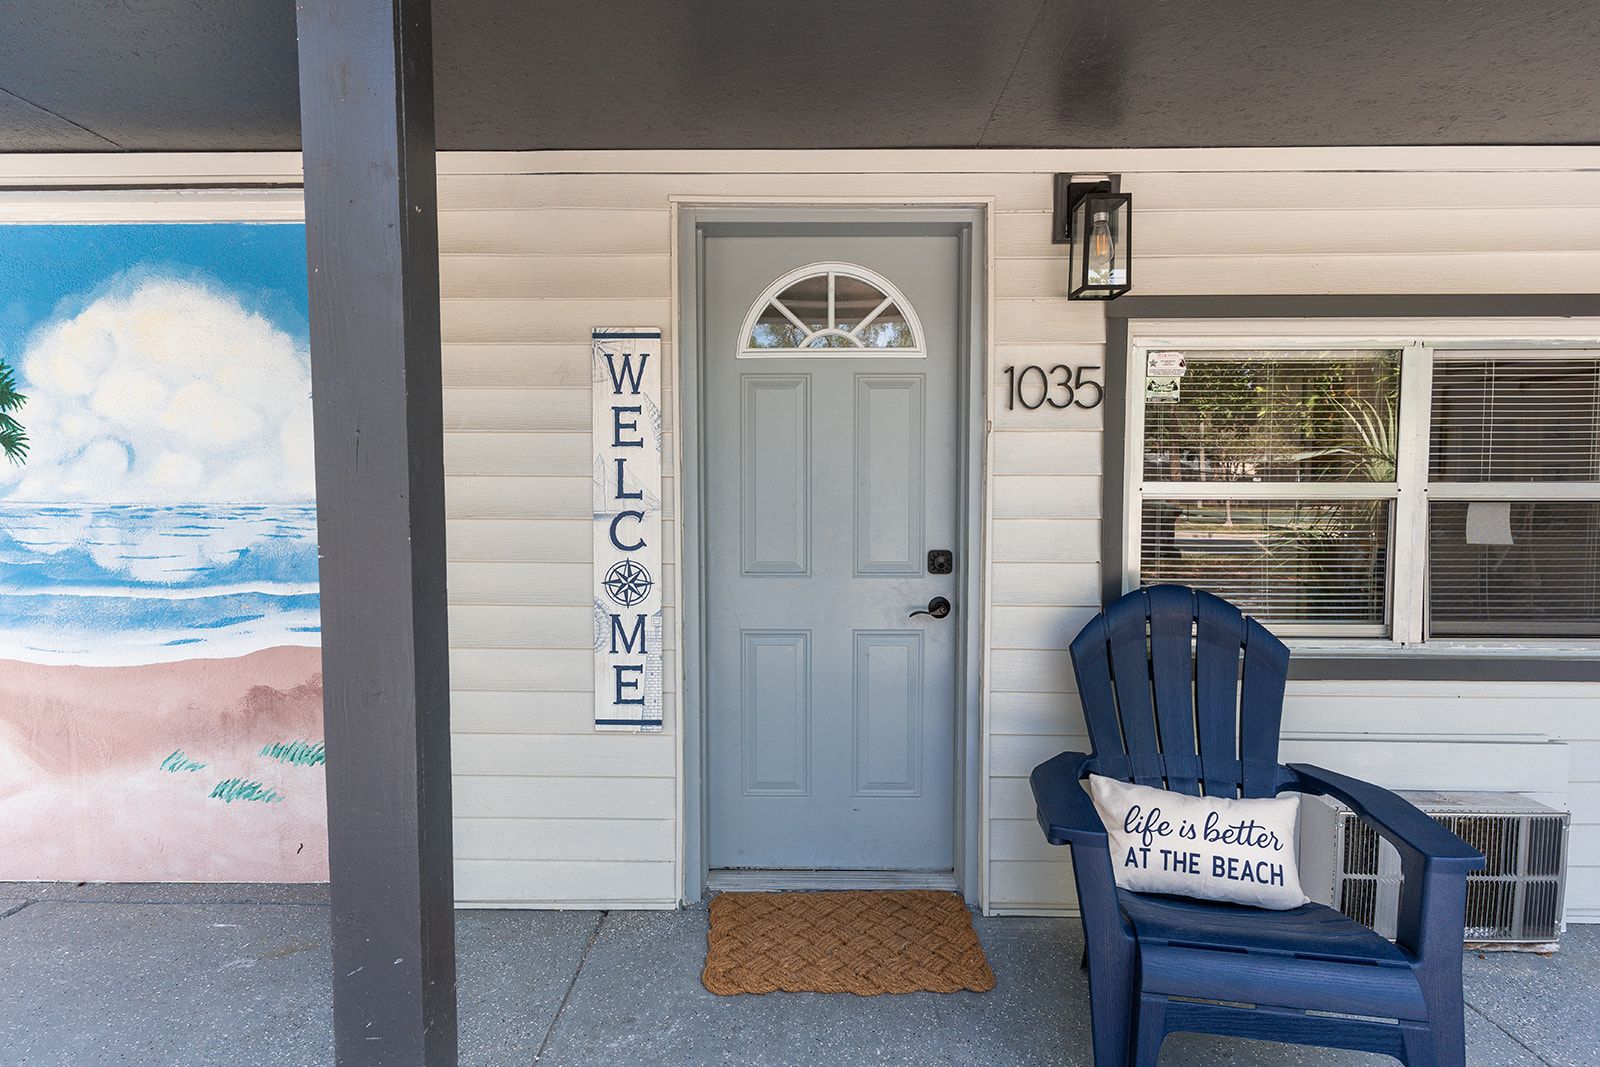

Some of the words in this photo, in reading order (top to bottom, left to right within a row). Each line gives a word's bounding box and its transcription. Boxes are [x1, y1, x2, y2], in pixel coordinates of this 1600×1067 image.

[1004, 364, 1103, 410] 1035
[1124, 805, 1173, 847] life
[1179, 820, 1197, 840] is
[1204, 811, 1284, 851] better
[1124, 847, 1151, 869] AT
[1160, 849, 1201, 874] THE
[1212, 855, 1284, 886] BEACH
